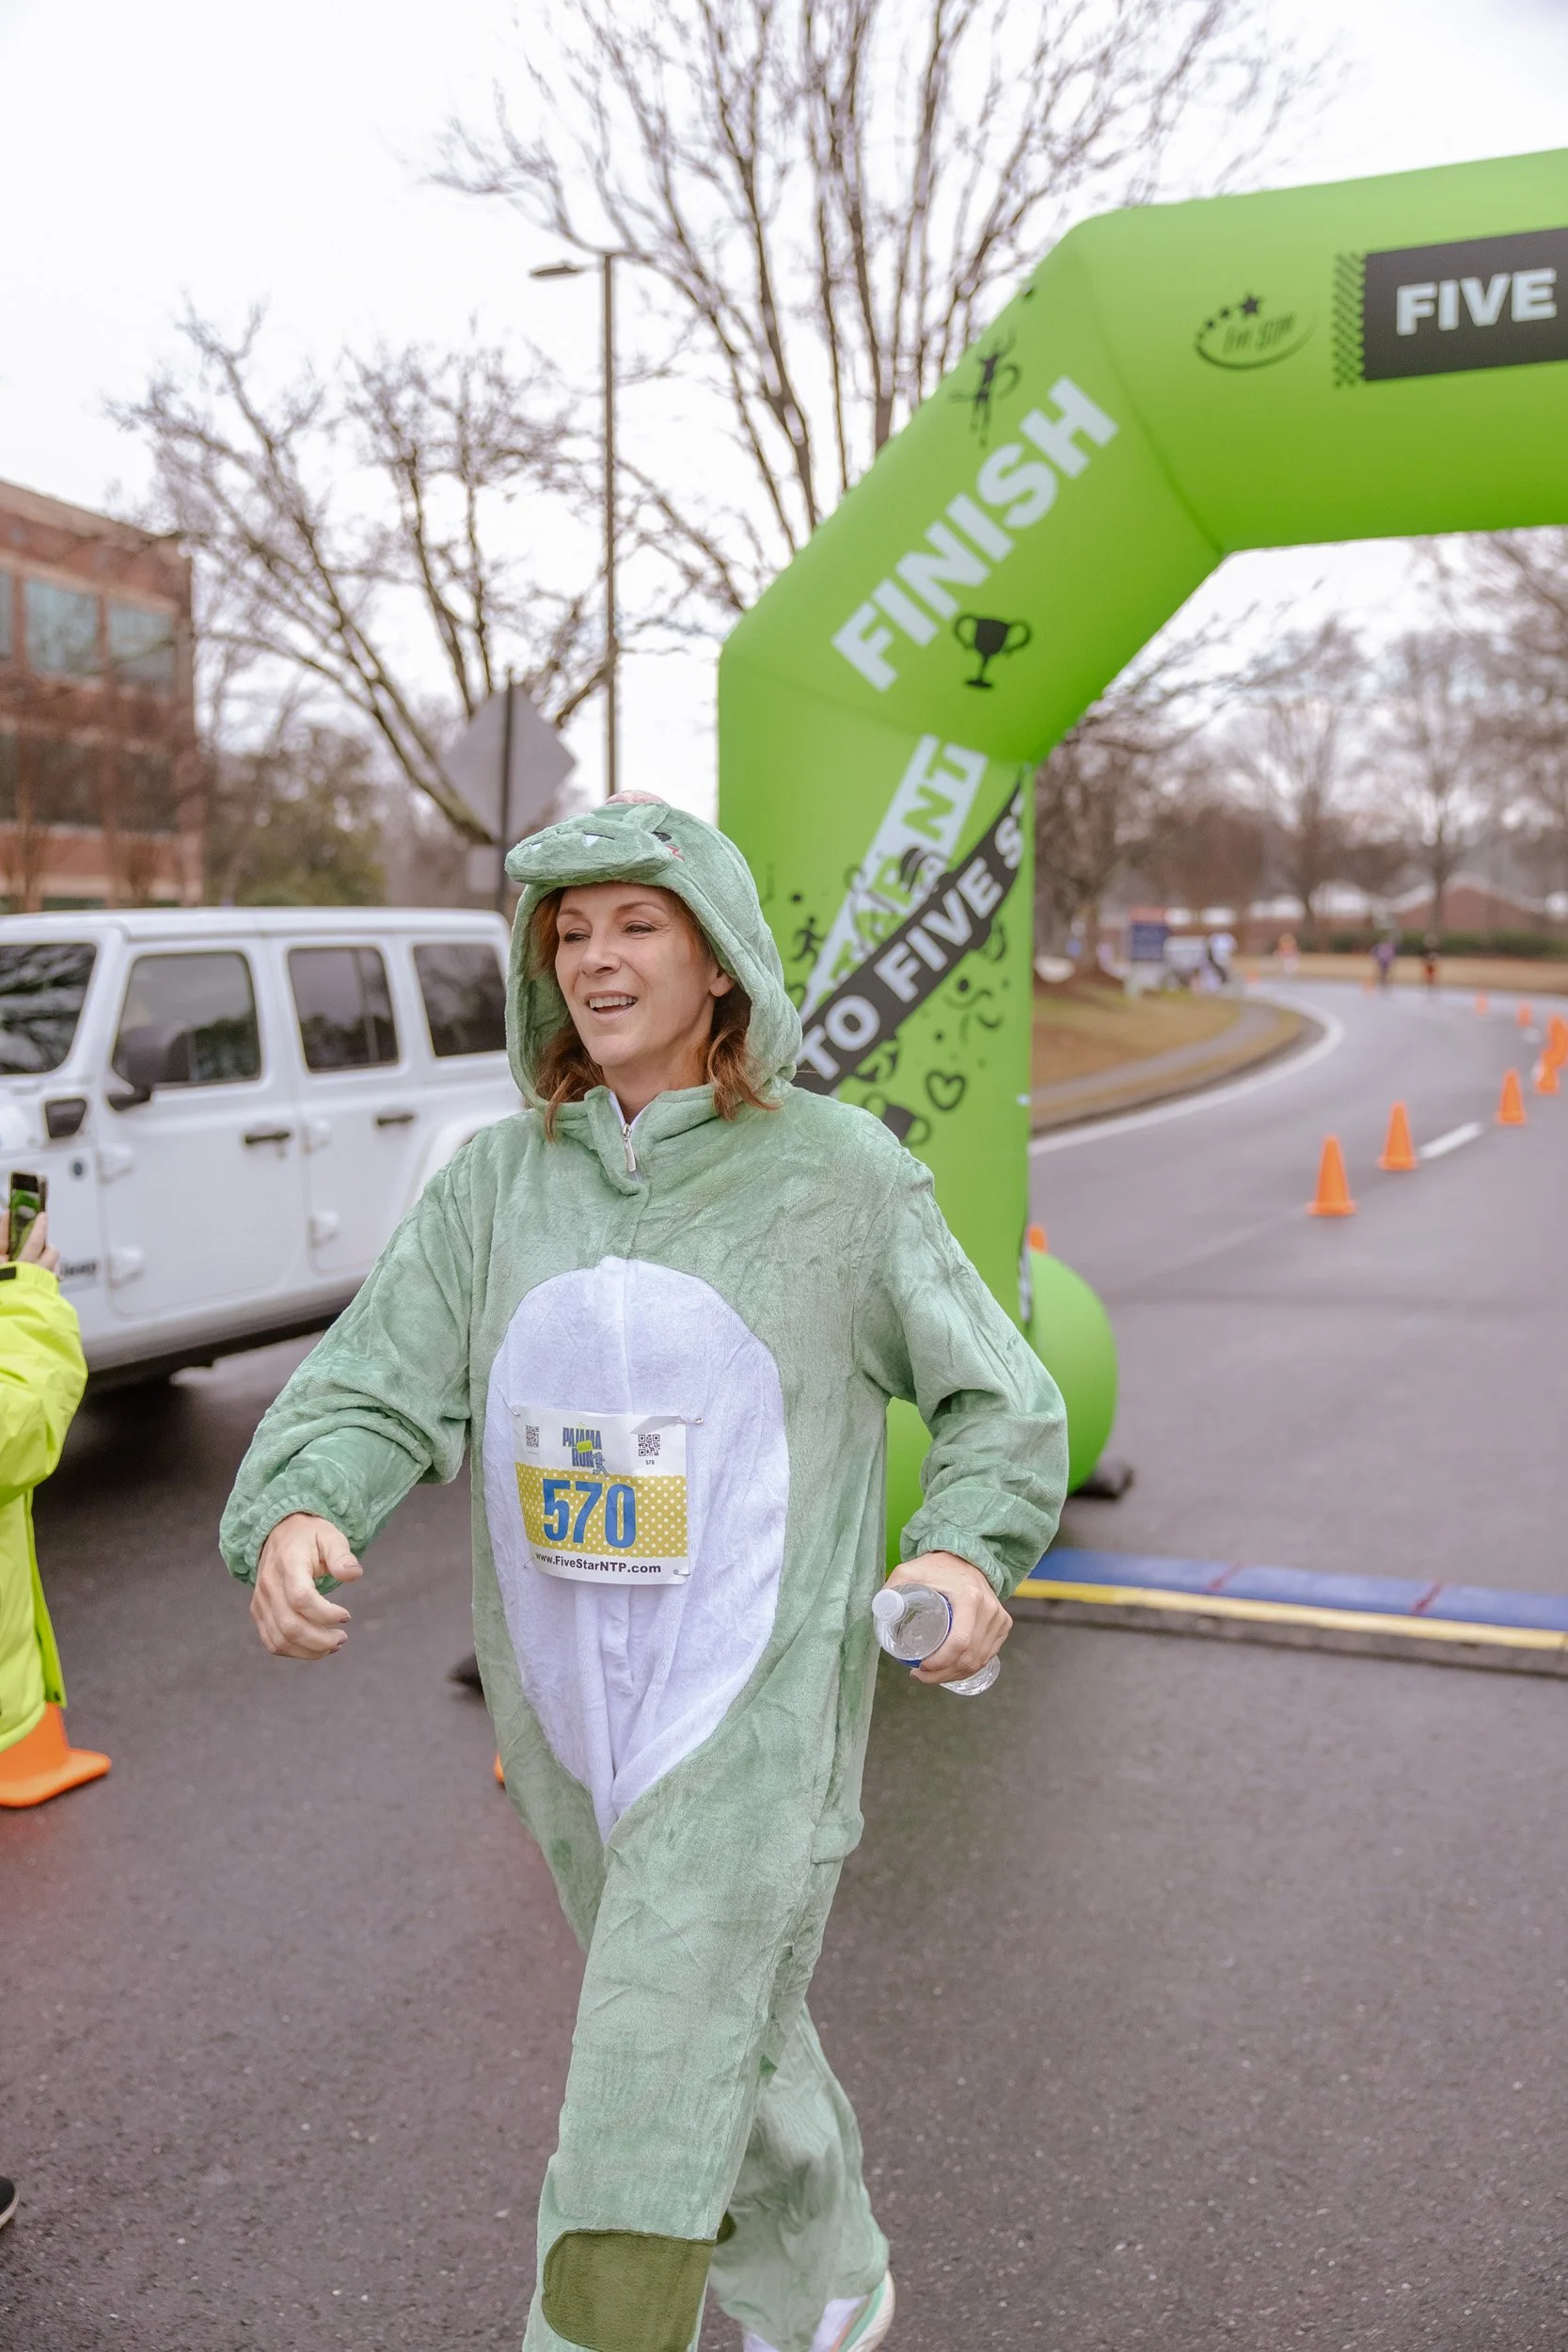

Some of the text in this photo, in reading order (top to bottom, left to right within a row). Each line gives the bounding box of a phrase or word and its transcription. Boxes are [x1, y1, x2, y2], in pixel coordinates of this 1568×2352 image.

[1396, 267, 1558, 336] FIVE
[831, 375, 1119, 692] FINISH
[796, 994, 881, 1081] TO
[873, 856, 1004, 1004] FIVE
[572, 1447, 594, 1467] RUN
[543, 1478, 637, 1549] 570
[535, 1552, 662, 1573] www.FiveStarNTP.com
